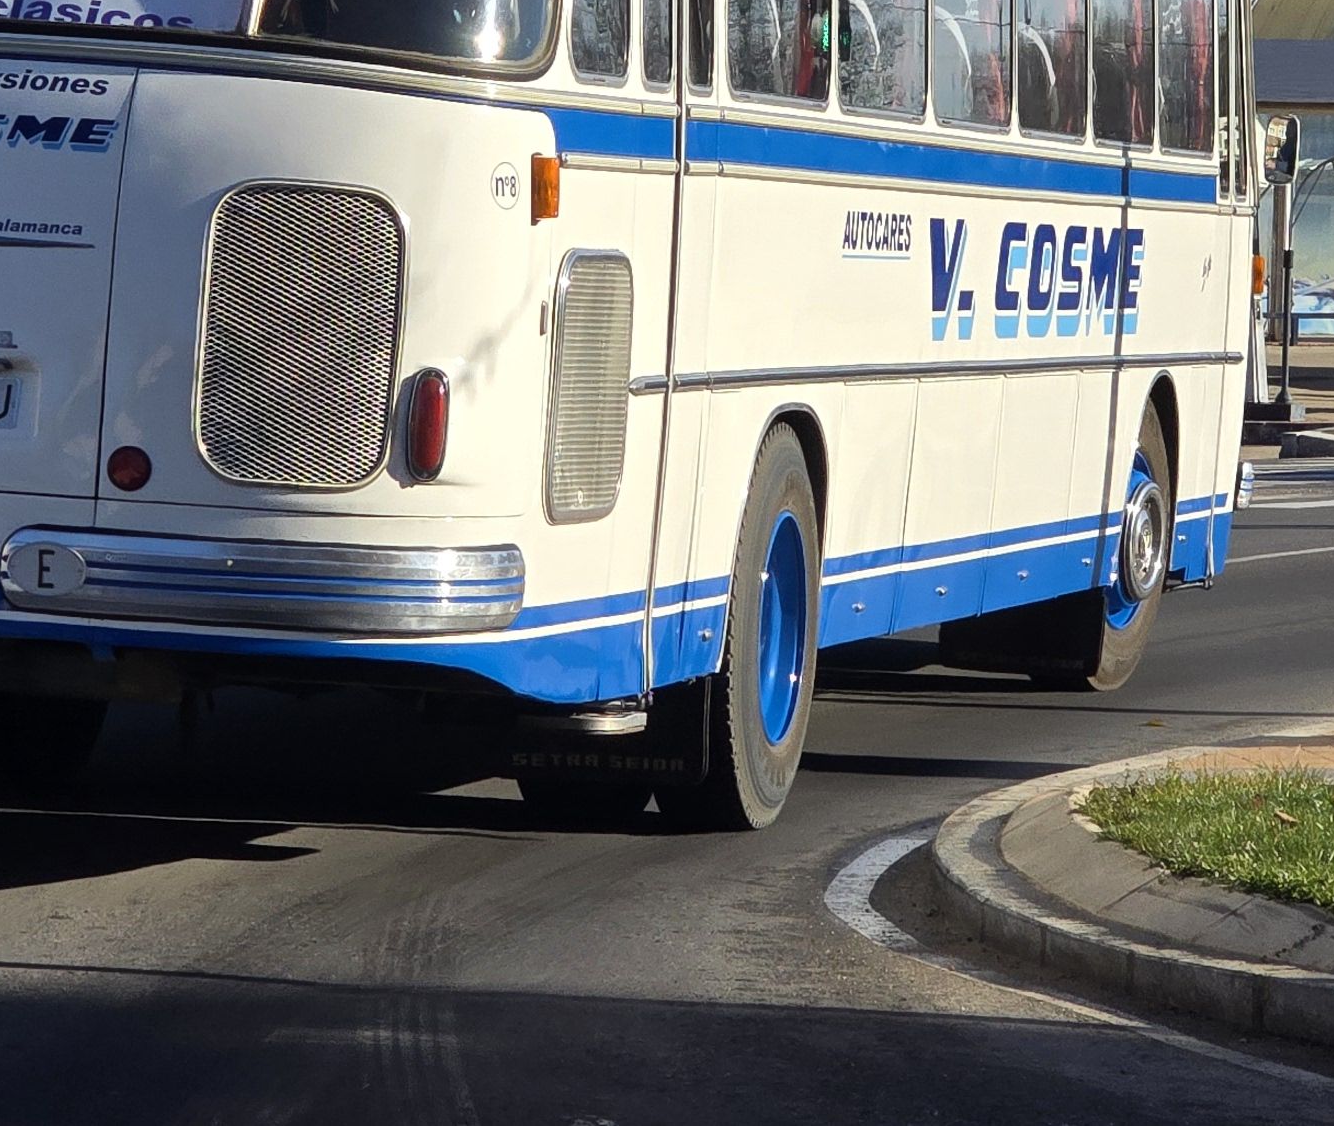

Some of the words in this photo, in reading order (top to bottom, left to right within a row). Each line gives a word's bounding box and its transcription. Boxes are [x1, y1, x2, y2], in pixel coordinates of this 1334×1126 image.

[842, 210, 913, 253] AUTOCARES
[929, 217, 976, 341] V.
[994, 222, 1145, 339] COSME
[36, 549, 56, 589] E
